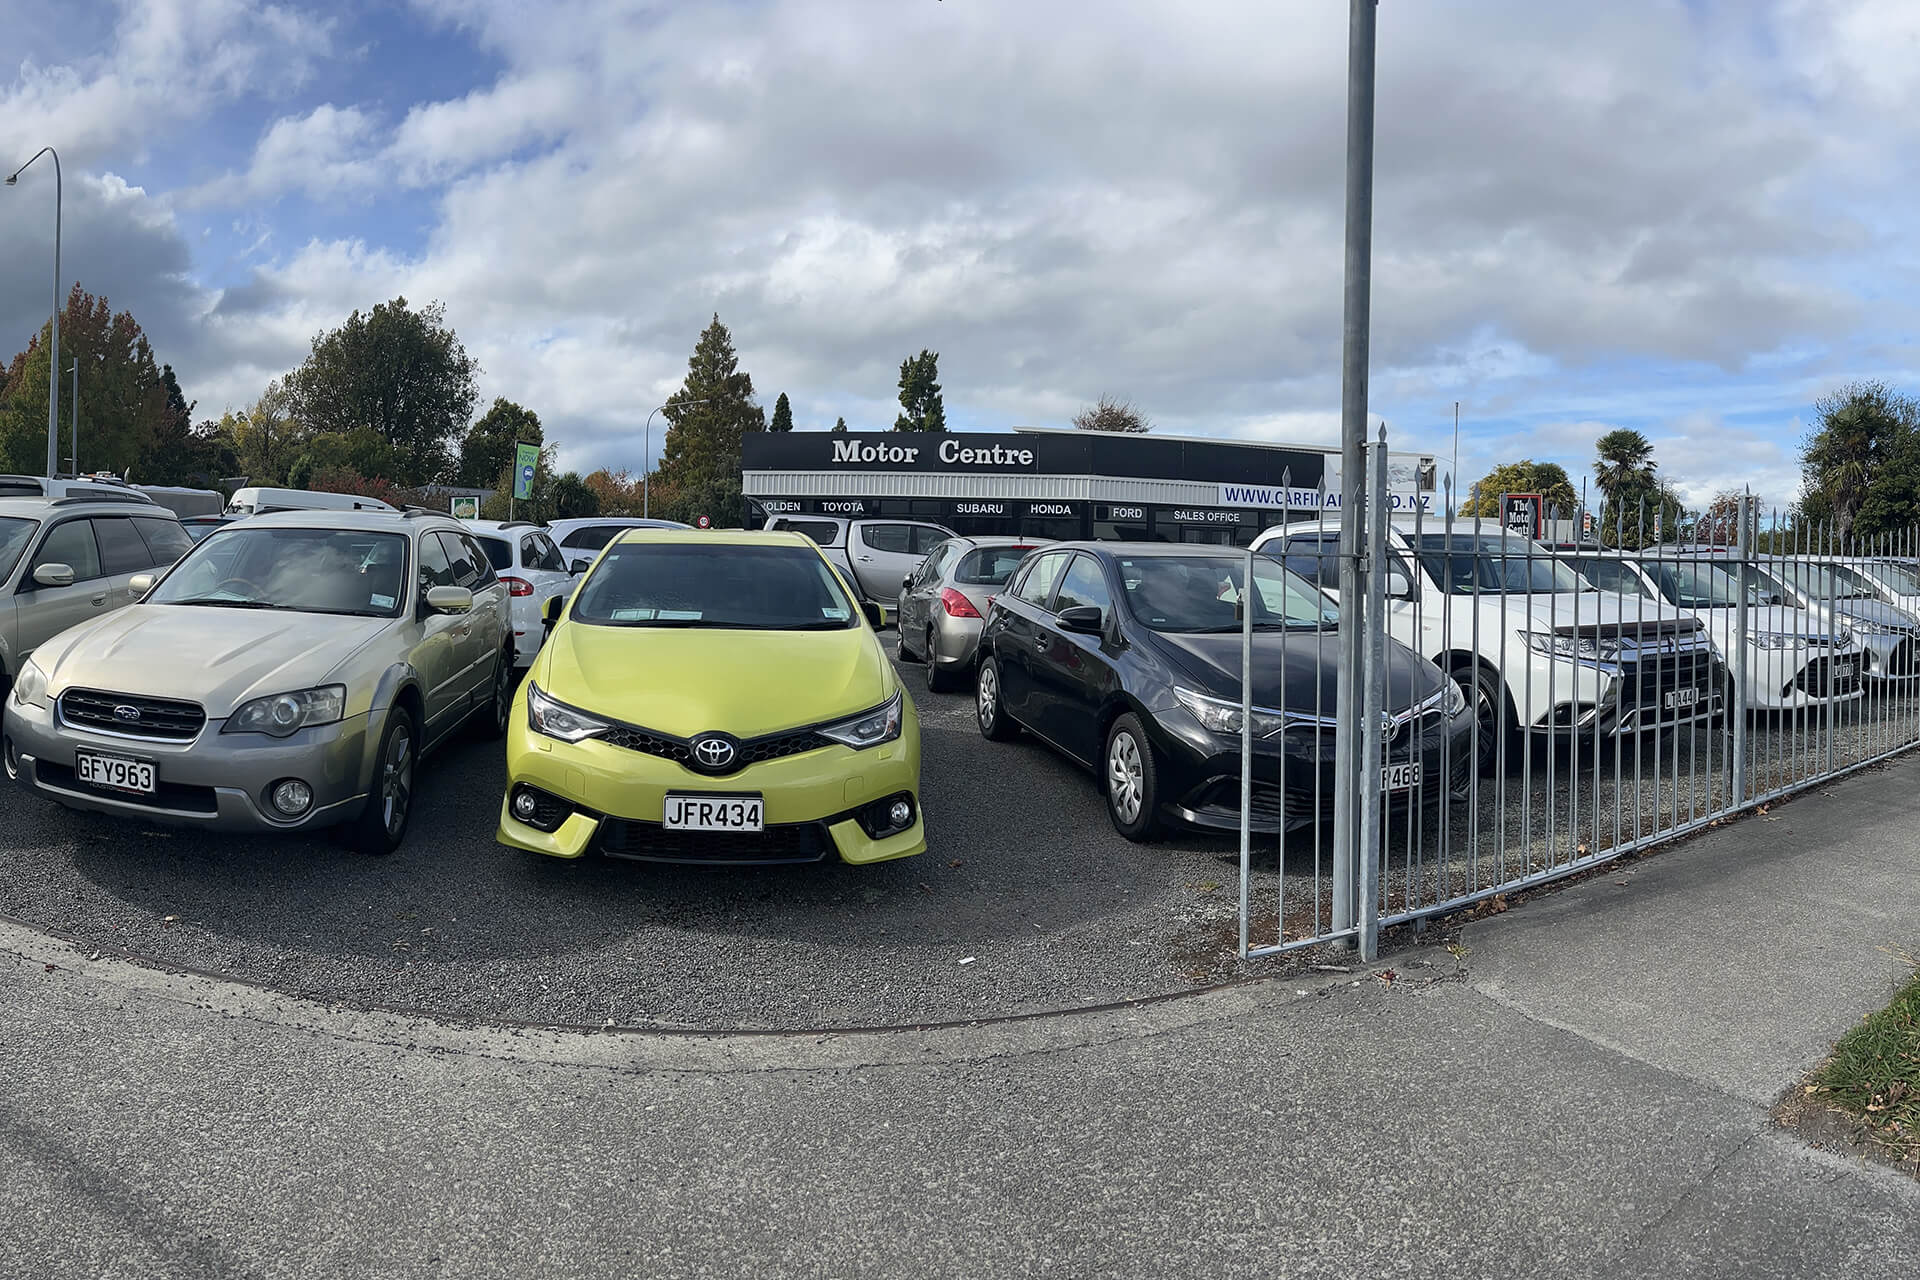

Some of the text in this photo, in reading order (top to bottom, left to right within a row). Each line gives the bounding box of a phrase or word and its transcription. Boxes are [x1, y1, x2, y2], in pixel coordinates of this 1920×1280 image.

[832, 439, 1034, 465] Motor Centre
[822, 502, 864, 512] TOYOTA
[956, 503, 1003, 514] SUBARU
[1030, 504, 1072, 515] HONDA
[1113, 507, 1143, 519] FORD
[1174, 510, 1240, 522] SALES OFFICE
[1508, 511, 1530, 523] Moto
[79, 757, 152, 789] GFY963
[668, 802, 760, 827] JFR434
